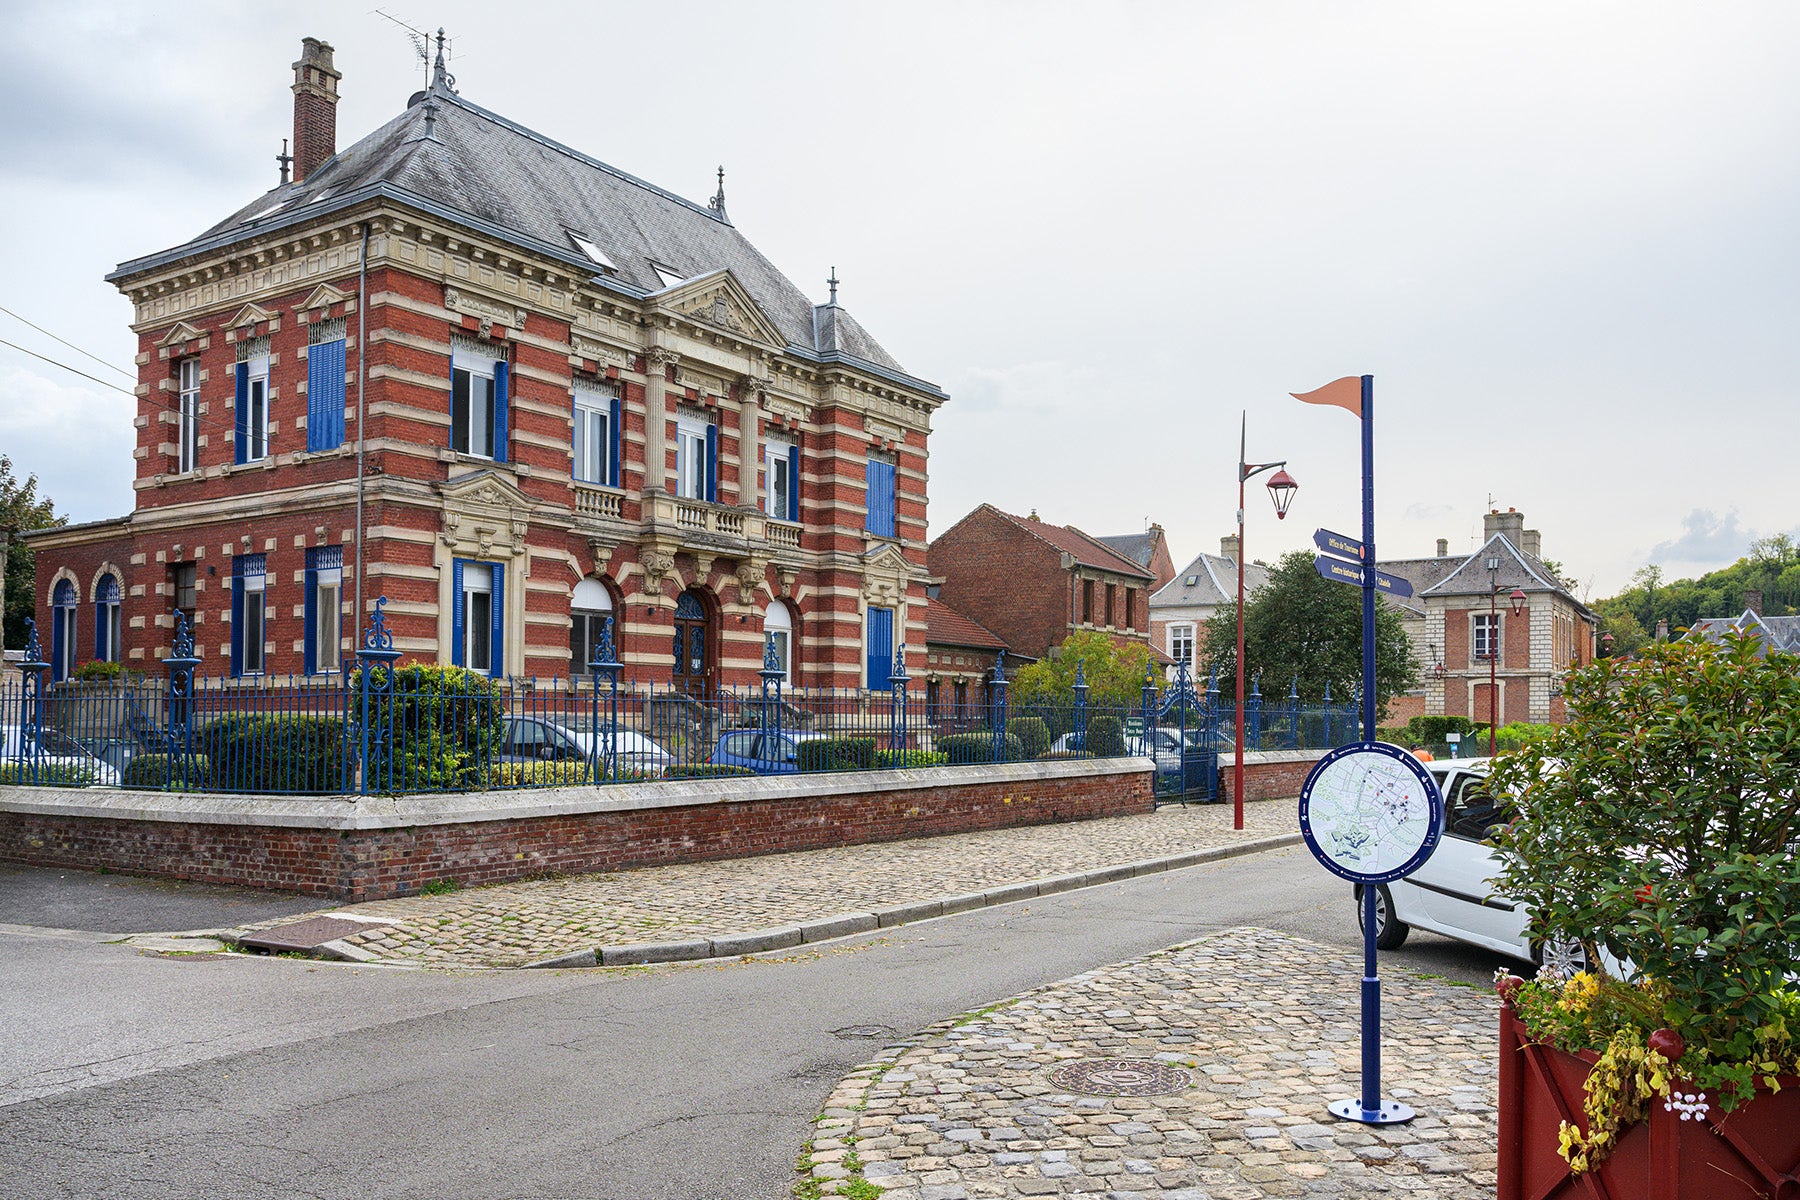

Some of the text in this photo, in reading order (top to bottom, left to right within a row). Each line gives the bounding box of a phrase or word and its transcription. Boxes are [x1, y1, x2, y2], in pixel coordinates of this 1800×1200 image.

[1331, 565, 1359, 579] Centre historique
[1378, 577, 1390, 587] Citadelle
